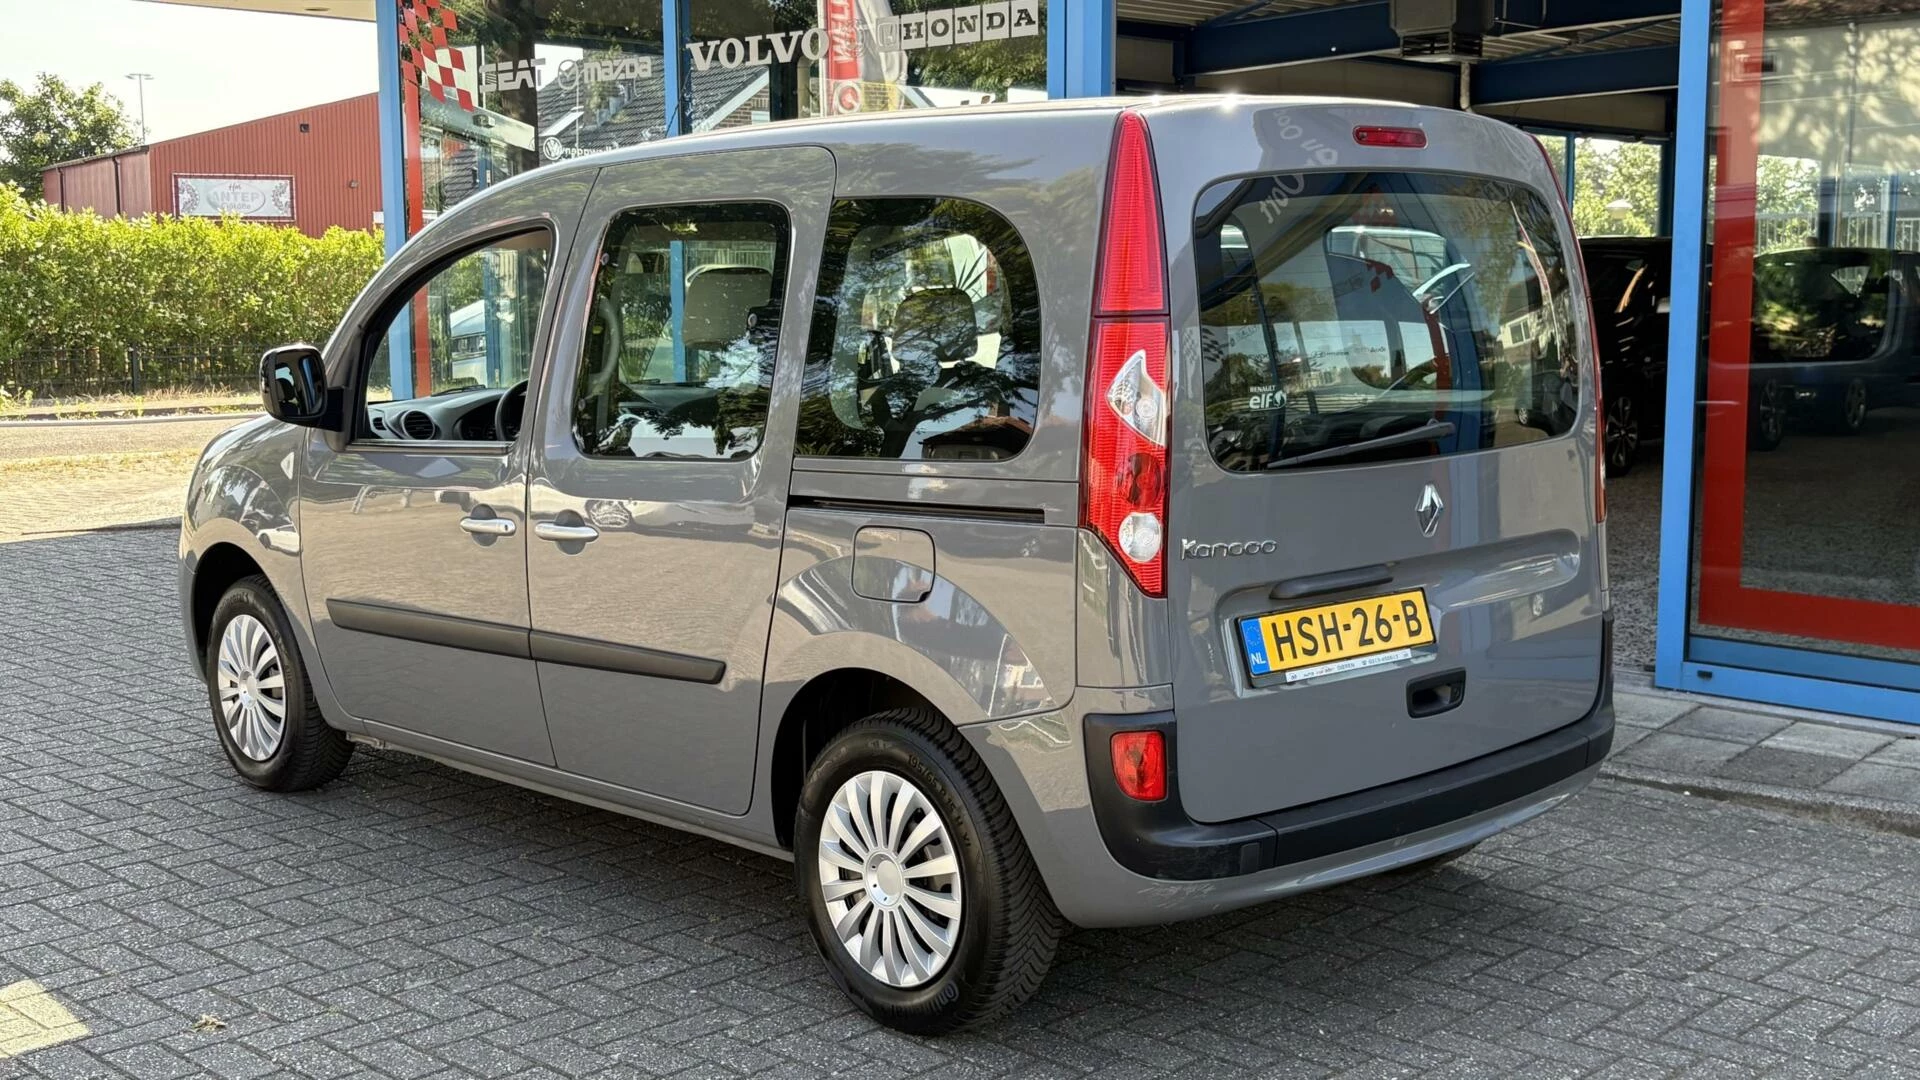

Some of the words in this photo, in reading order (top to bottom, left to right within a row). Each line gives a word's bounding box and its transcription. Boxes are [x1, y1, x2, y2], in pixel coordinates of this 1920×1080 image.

[903, 8, 1037, 40] HONDA
[685, 27, 831, 71] VOLVO
[478, 57, 546, 93] SEAT
[1249, 385, 1276, 393] RENAULT
[1249, 393, 1274, 409] elf
[1251, 652, 1267, 666] NL
[1271, 600, 1423, 662] HSH-26-B
